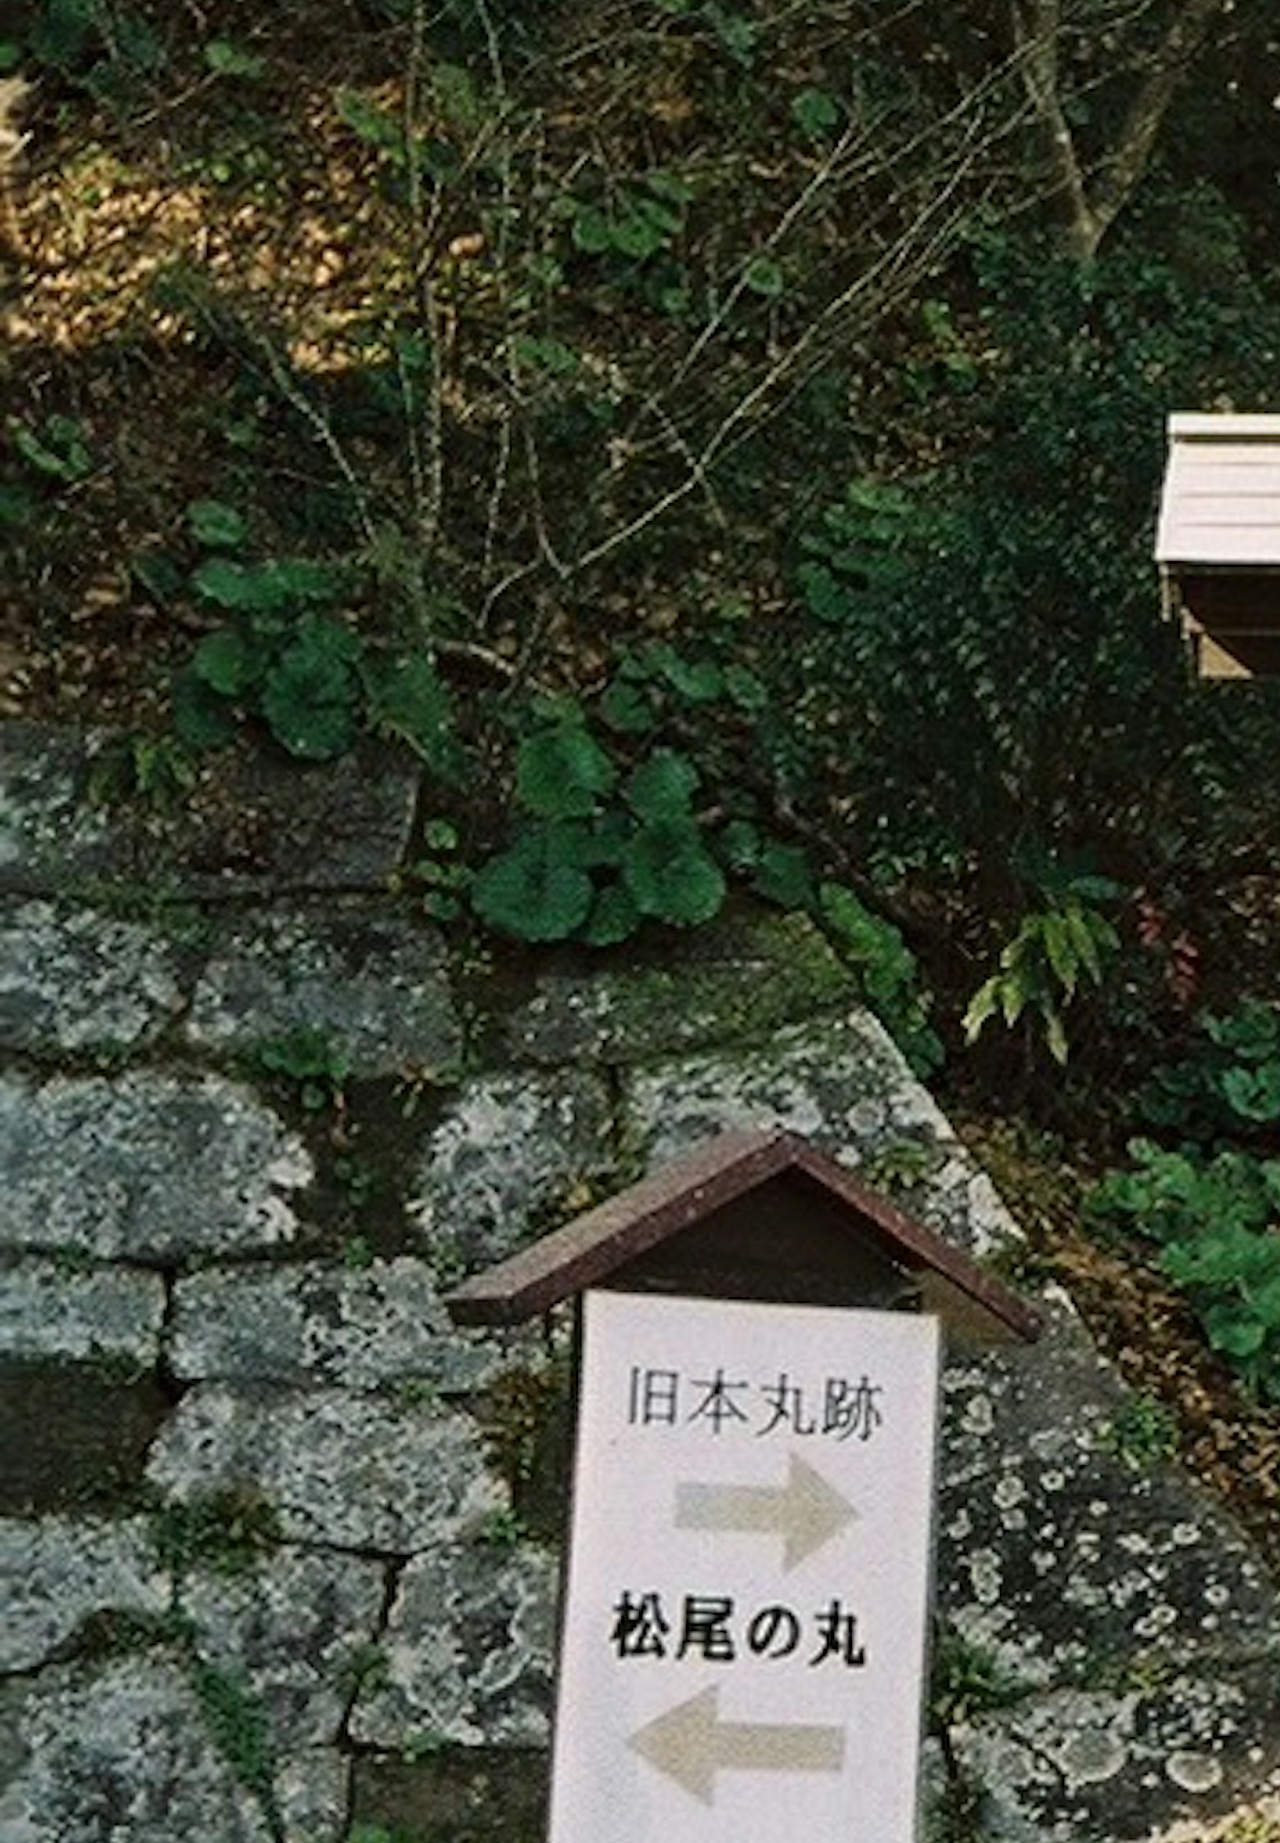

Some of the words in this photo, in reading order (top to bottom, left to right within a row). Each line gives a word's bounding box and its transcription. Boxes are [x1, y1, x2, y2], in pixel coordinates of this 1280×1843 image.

[626, 1365, 885, 1443] 旧本丸跡
[610, 1589, 866, 1668] 松尾の丸
